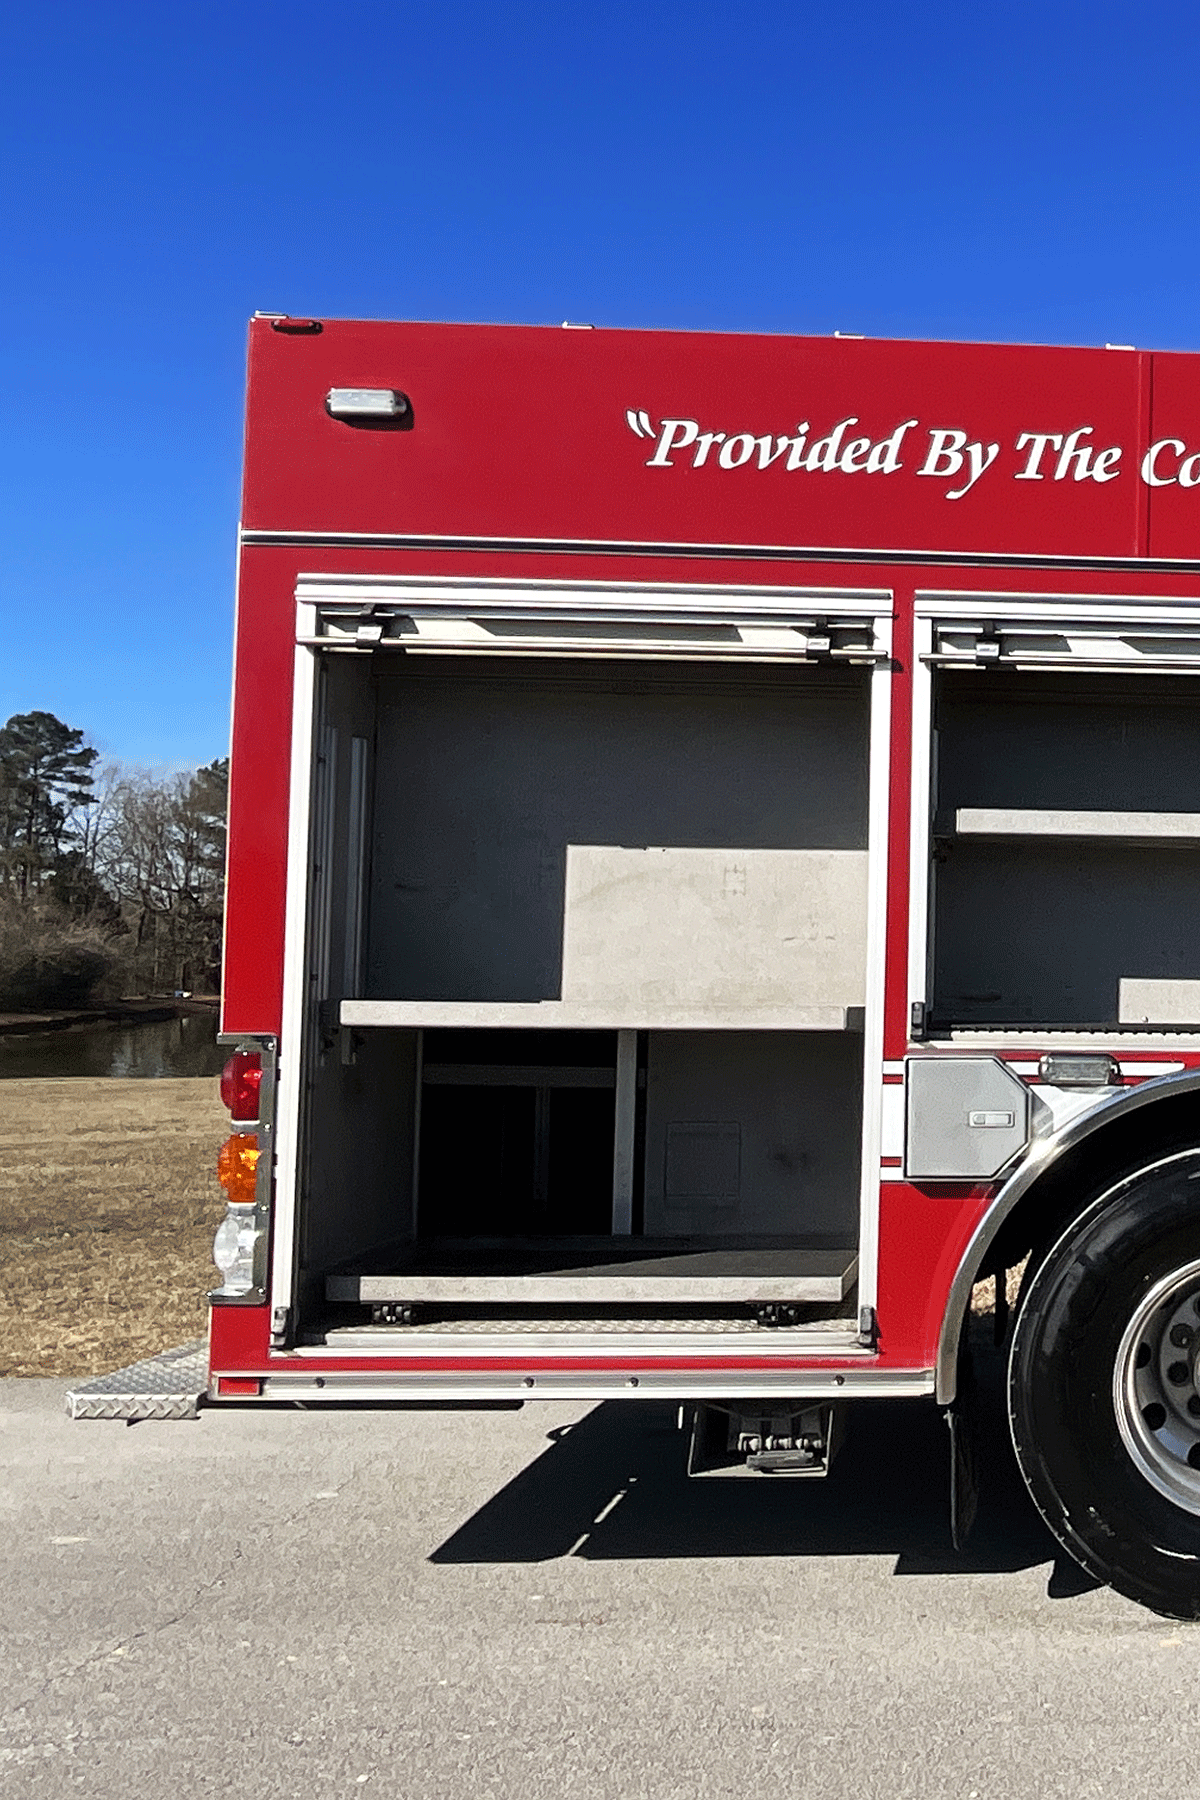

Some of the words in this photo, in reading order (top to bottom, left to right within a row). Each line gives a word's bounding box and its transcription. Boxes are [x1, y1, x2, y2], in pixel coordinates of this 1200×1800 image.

[626, 410, 919, 475] “Provided
[916, 429, 1000, 500] By
[1014, 426, 1123, 483] The
